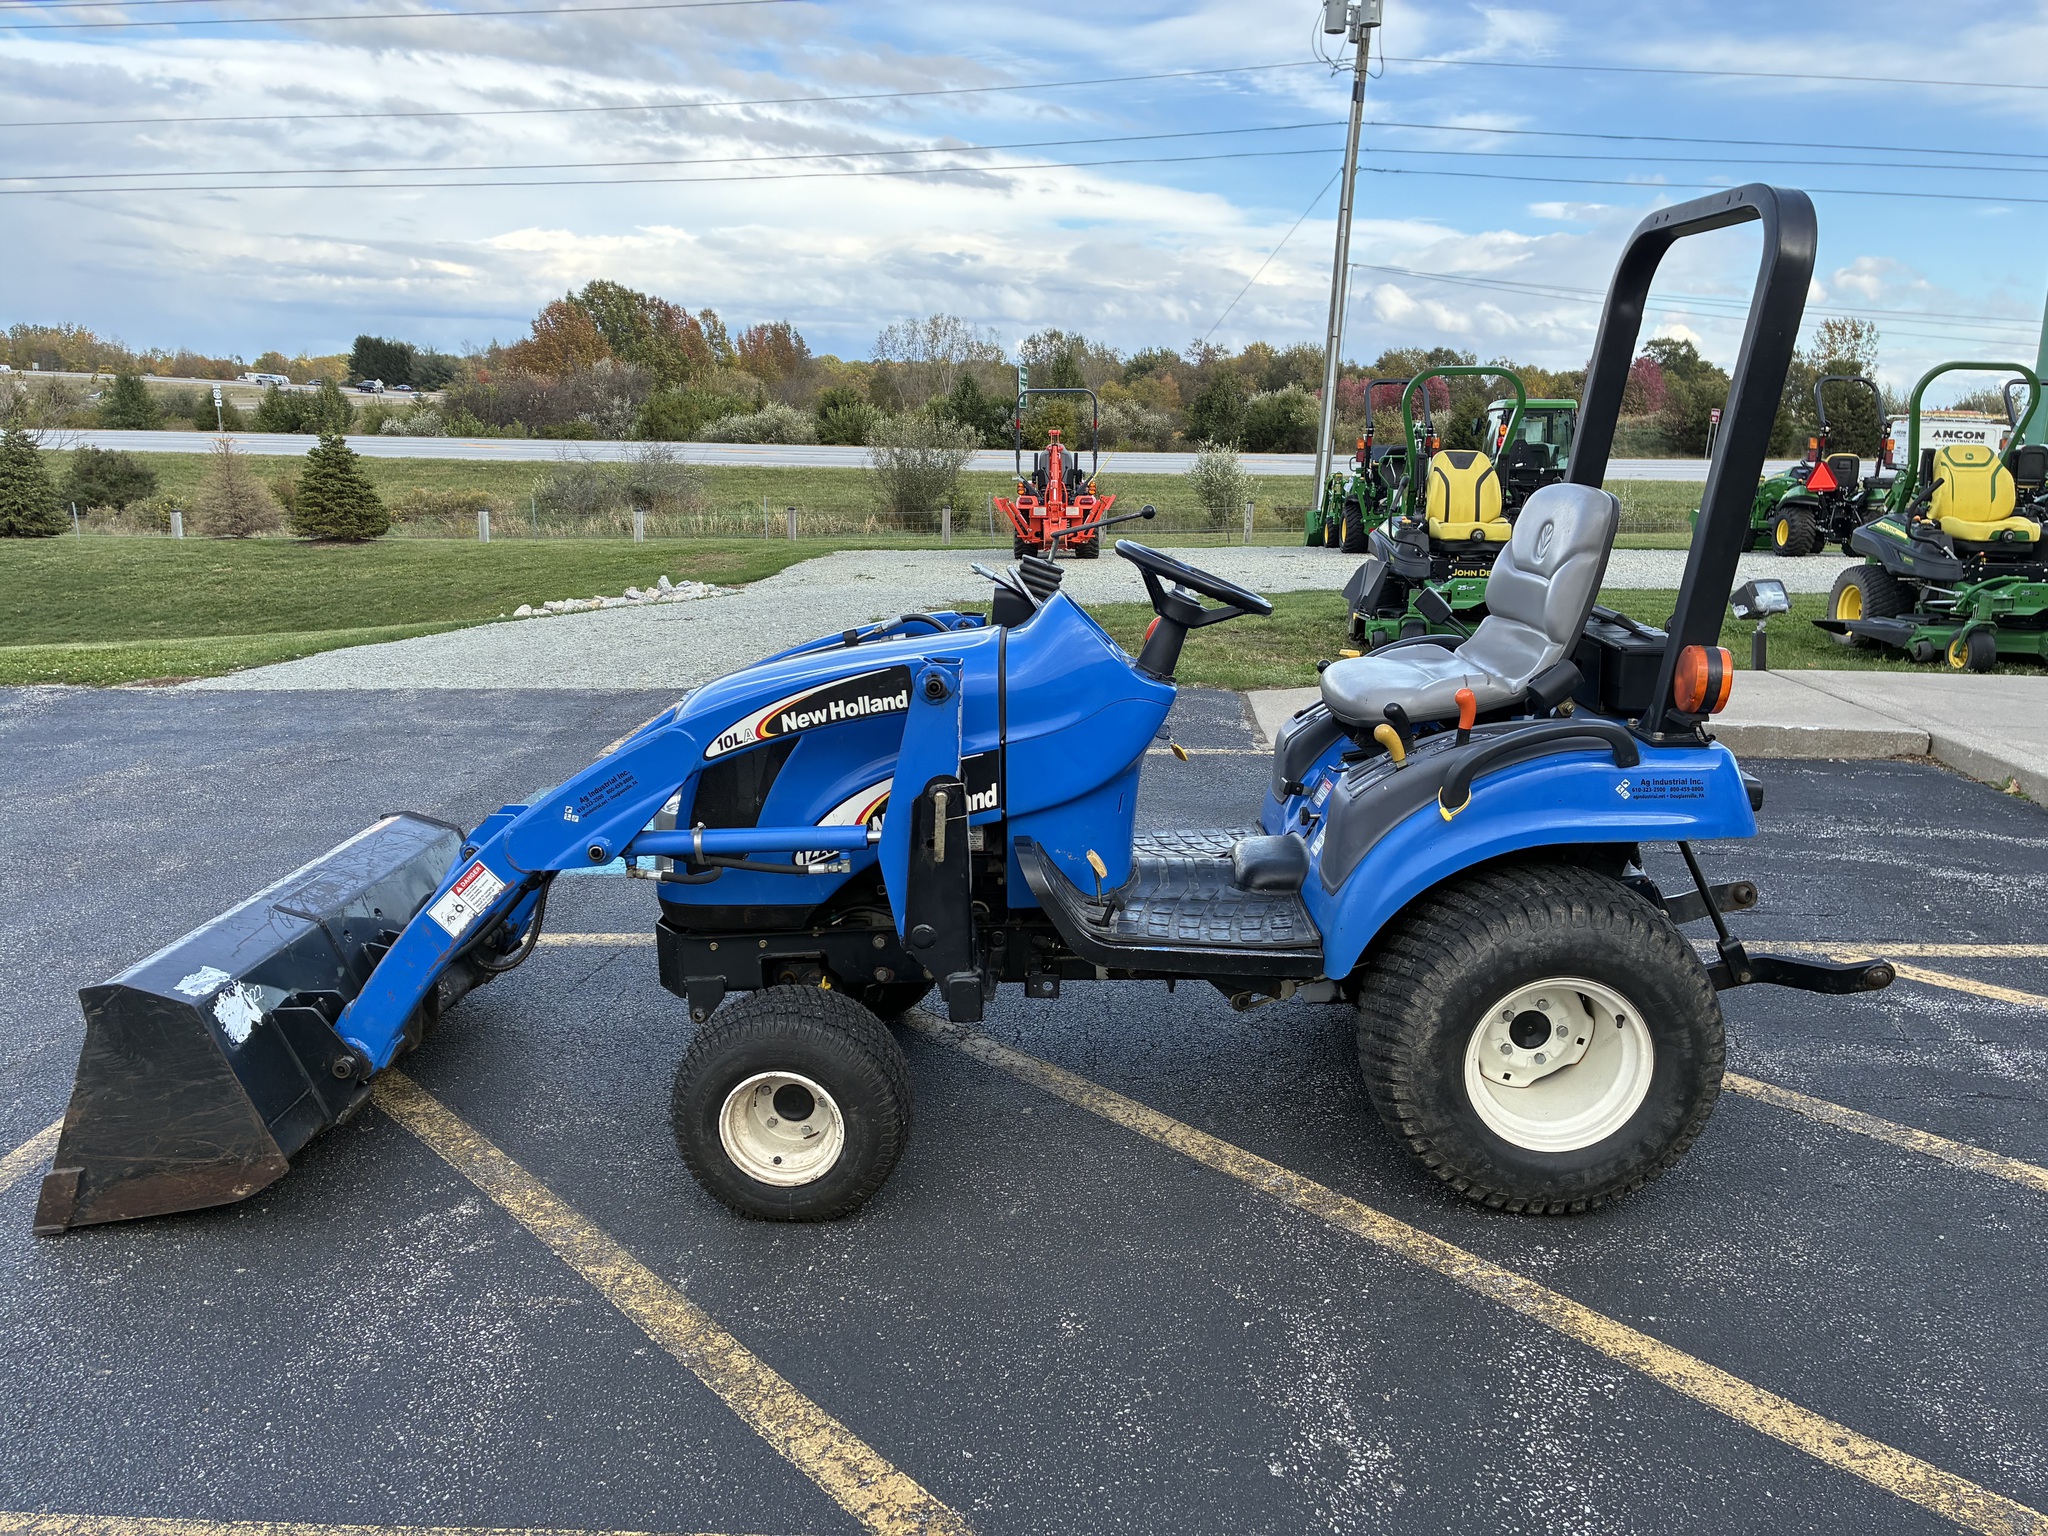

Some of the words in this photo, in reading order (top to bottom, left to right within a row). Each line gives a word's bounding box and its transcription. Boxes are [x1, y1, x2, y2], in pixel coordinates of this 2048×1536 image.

[1932, 429, 1985, 440] ANCON
[1452, 568, 1477, 577] JOHN
[781, 709, 828, 733] New
[829, 690, 909, 720] Holland
[717, 728, 755, 751] 10LA
[579, 794, 589, 804] Ag
[588, 775, 618, 797] Industrial
[616, 770, 630, 780] Inc.
[1641, 778, 1650, 787] Ag
[460, 866, 482, 888] DANGER
